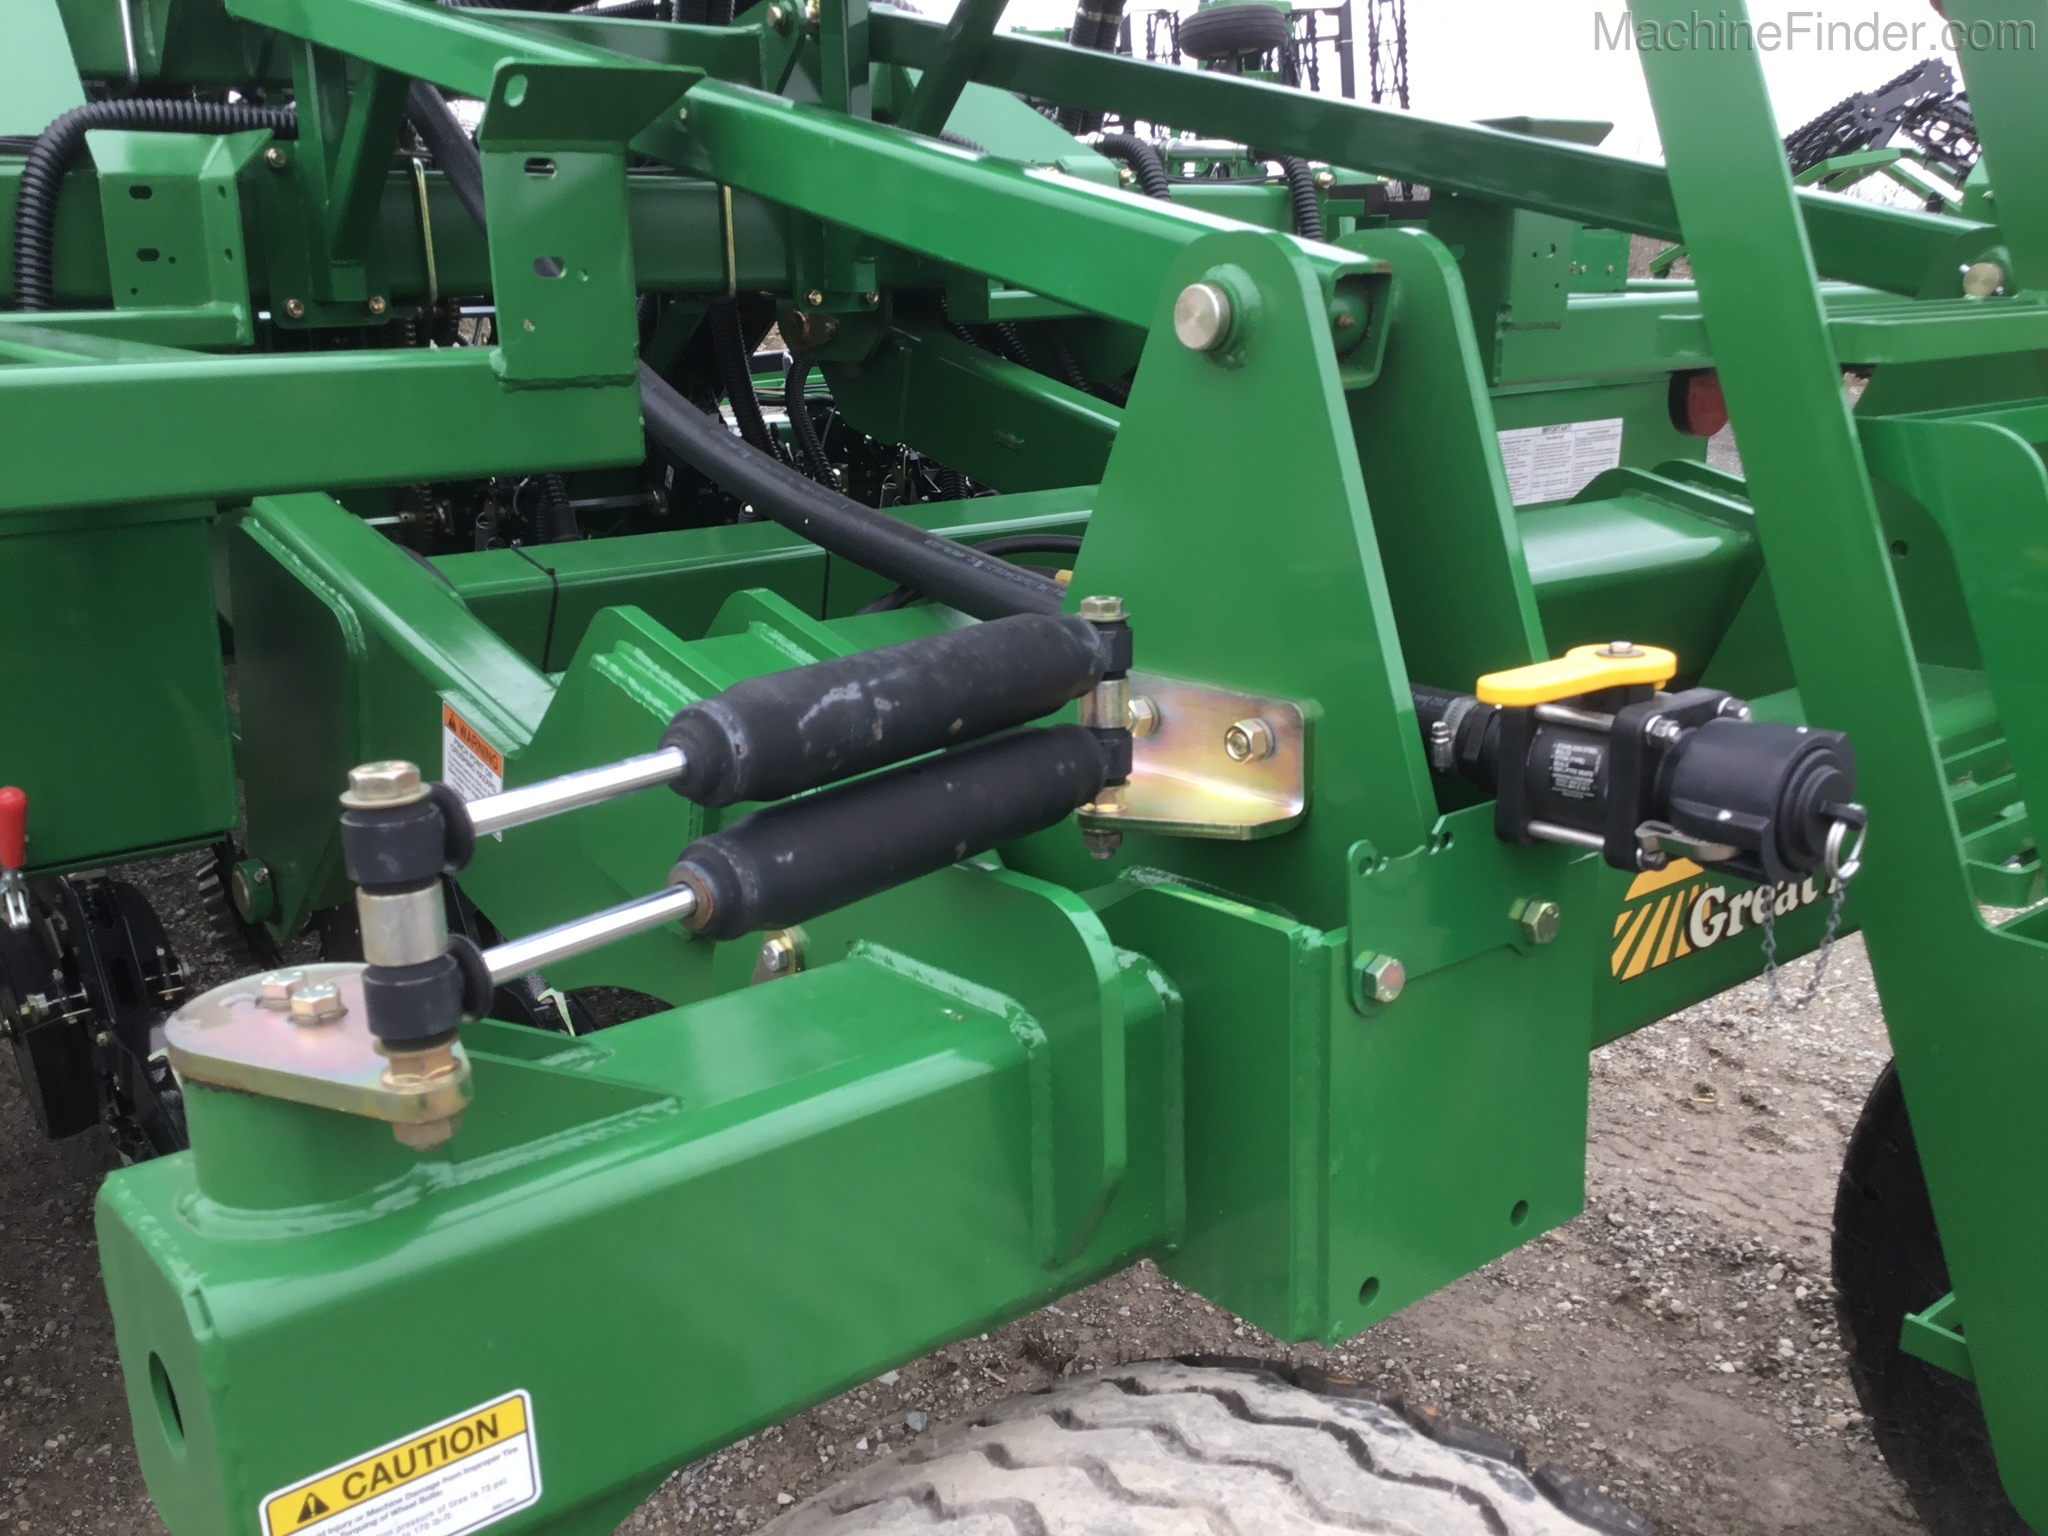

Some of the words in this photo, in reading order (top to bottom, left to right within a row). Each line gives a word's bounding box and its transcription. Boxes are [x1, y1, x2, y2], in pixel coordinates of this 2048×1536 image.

[459, 720, 498, 771] WARNING
[1690, 876, 1818, 948] Great
[342, 1413, 498, 1501] CAUTION
[327, 1520, 352, 1535] Injury
[354, 1514, 364, 1523] or
[366, 1498, 403, 1517] Machine
[405, 1481, 441, 1500] Damage
[442, 1471, 462, 1484] from
[463, 1453, 500, 1477] Improper
[503, 1446, 518, 1457] Tire
[340, 1519, 378, 1536] Torquing
[379, 1513, 389, 1522] of
[390, 1500, 417, 1517] Wheel
[419, 1490, 443, 1505] Bolts:
[396, 1511, 434, 1533] pressure
[437, 1504, 446, 1514] of
[448, 1495, 468, 1509] tires
[470, 1491, 478, 1499] is
[481, 1484, 491, 1494] 73
[493, 1477, 509, 1490] psi.
